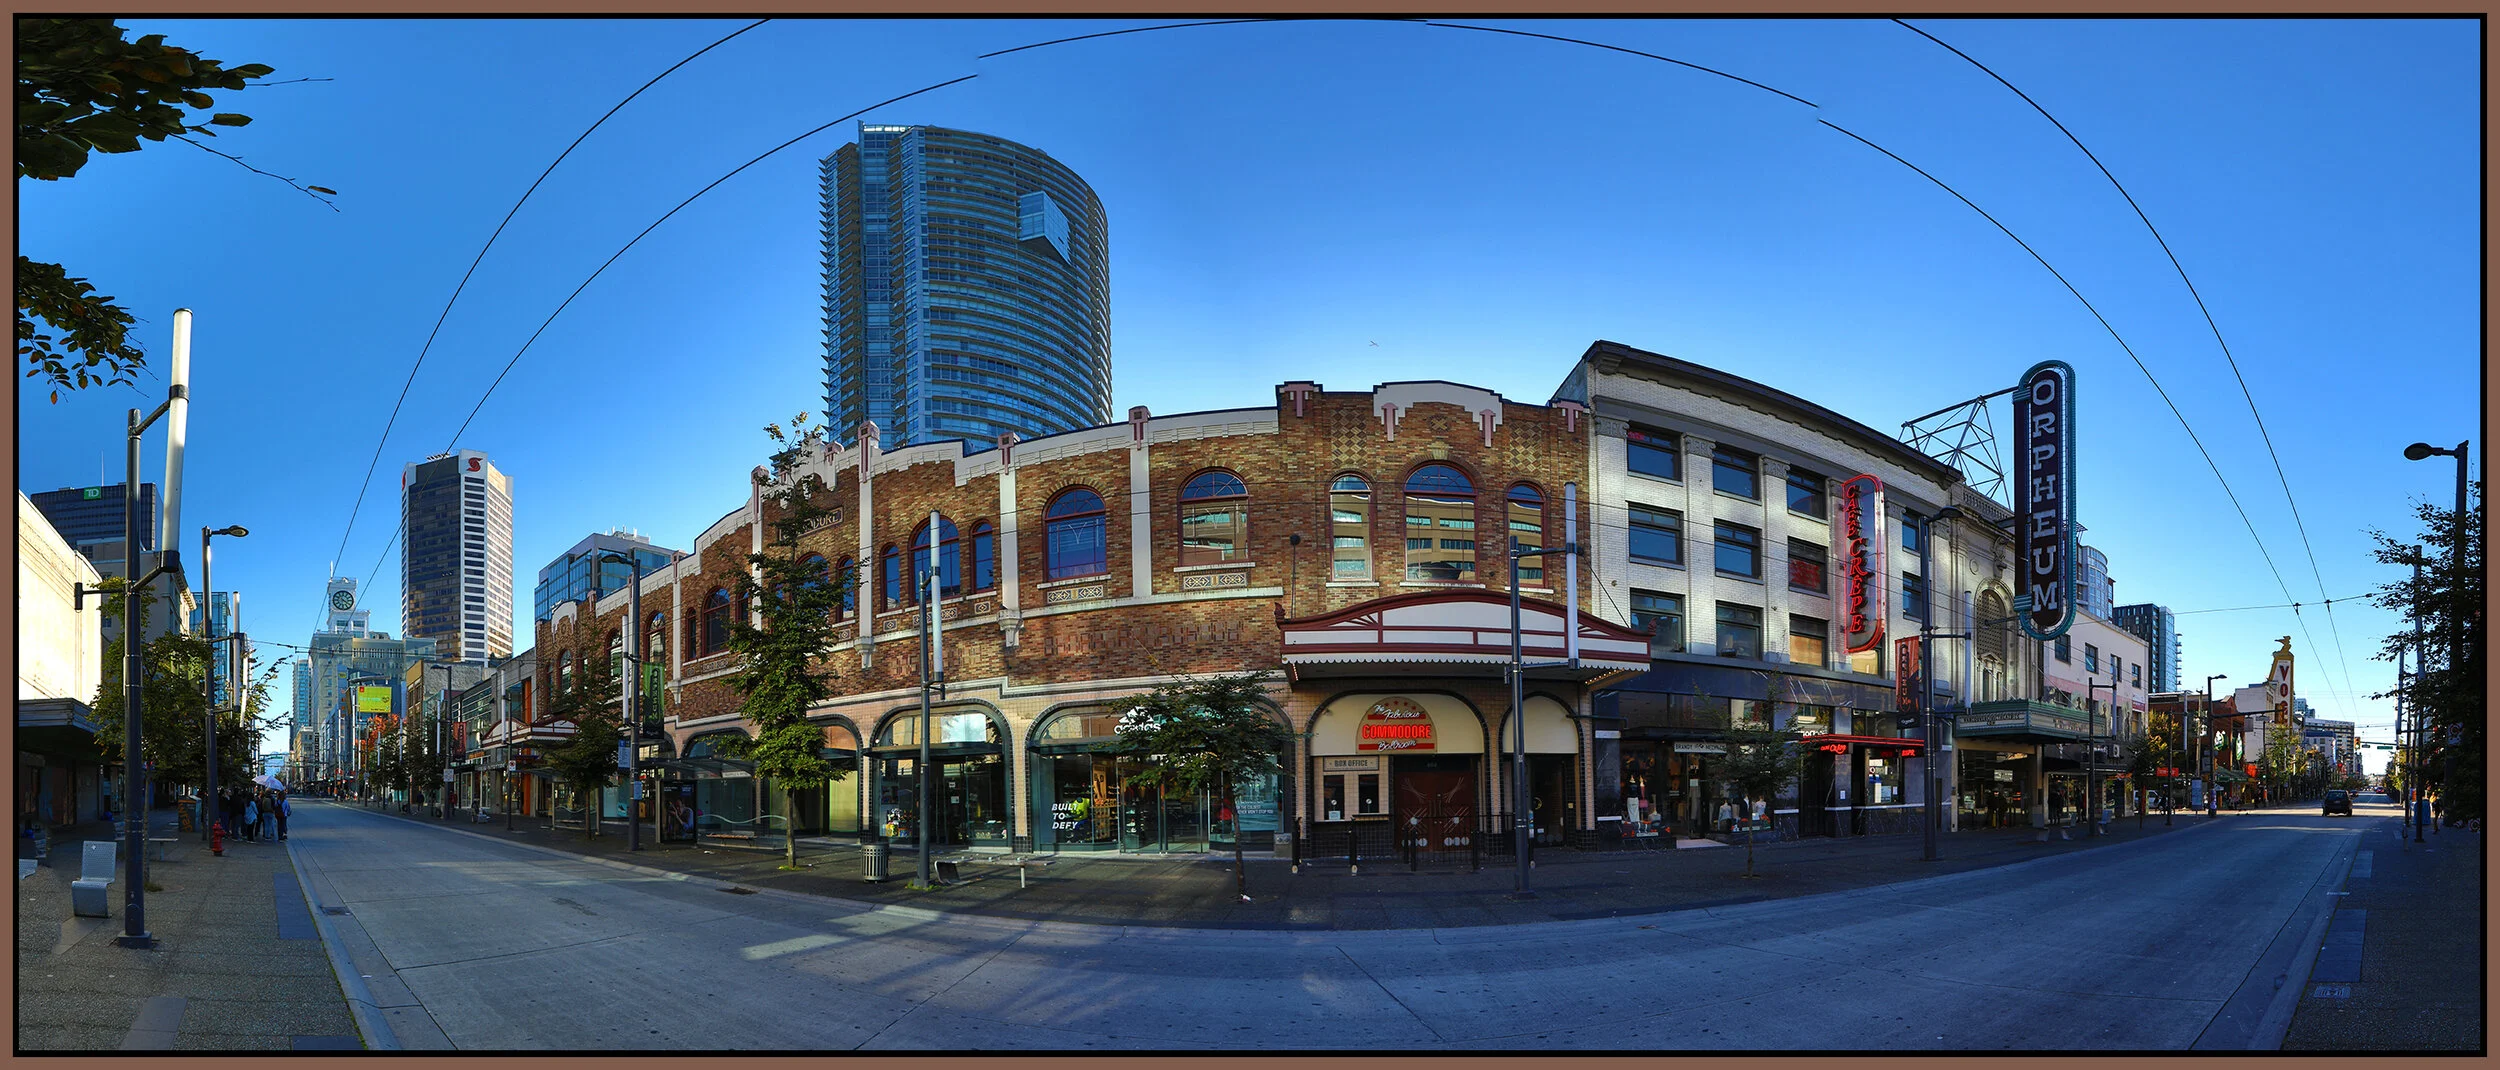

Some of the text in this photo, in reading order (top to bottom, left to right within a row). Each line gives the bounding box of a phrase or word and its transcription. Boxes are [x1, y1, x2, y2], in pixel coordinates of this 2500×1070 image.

[85, 488, 100, 498] TD
[2032, 379, 2058, 612] ORPHEUM
[1374, 704, 1386, 714] The
[1362, 724, 1432, 739] COMMODORE
[1378, 740, 1417, 752] Ballroom
[1348, 759, 1368, 767] OFFICE
[1051, 803, 1079, 811] BUILT
[1051, 822, 1079, 830] DEFY
